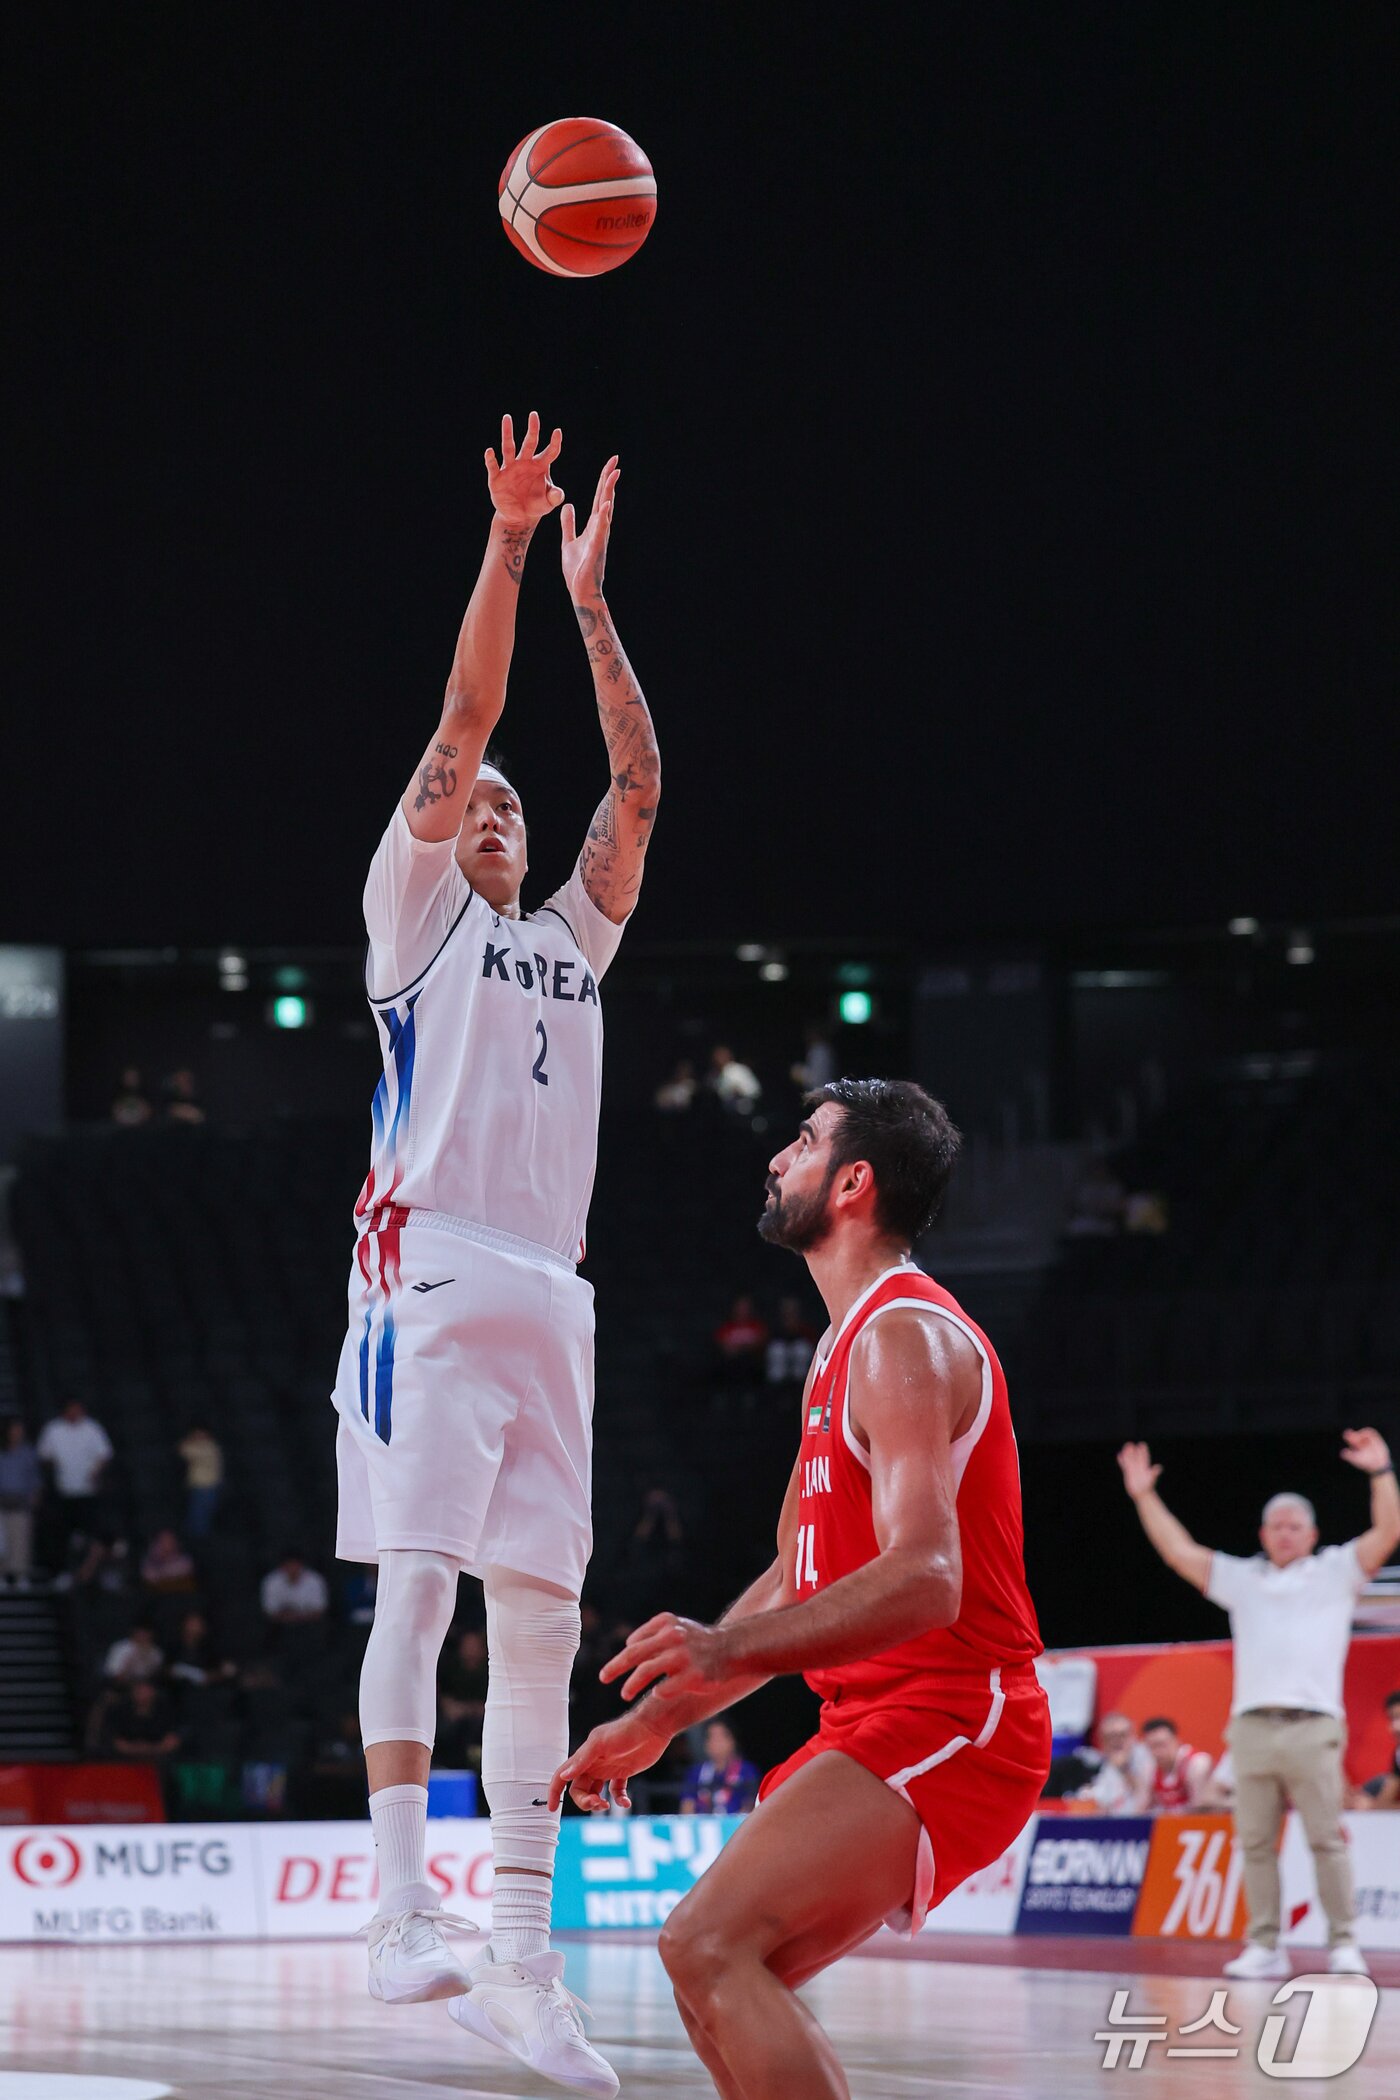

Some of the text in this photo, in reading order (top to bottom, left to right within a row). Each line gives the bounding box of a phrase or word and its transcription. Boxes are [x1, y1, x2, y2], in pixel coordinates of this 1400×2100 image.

[595, 211, 650, 231] molten
[482, 941, 599, 1007] KOREA
[532, 1019, 549, 1086] 2
[795, 1524, 819, 1590] 14
[95, 1841, 232, 1877] MUFG
[581, 1821, 723, 1881] ニトリ
[275, 1852, 494, 1903] DESO
[33, 1905, 219, 1934] MUFG Bank
[585, 1889, 690, 1927] NITO
